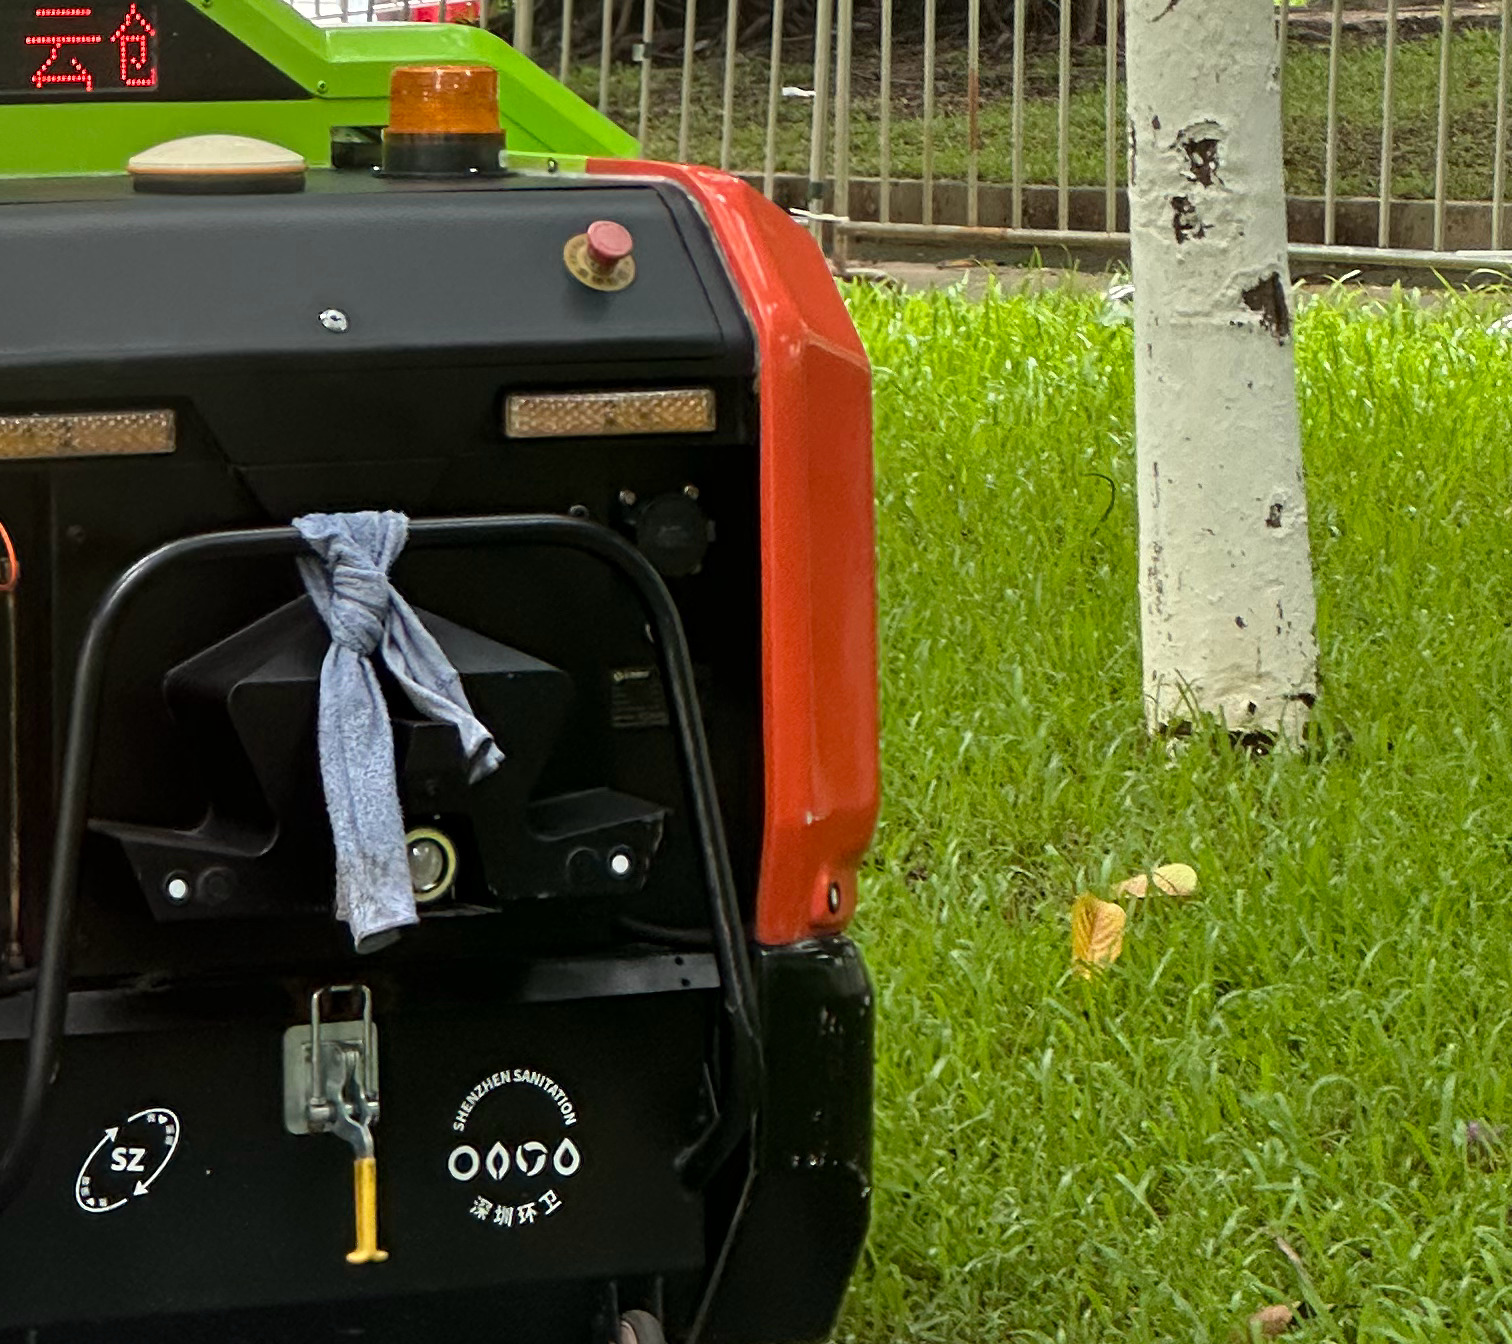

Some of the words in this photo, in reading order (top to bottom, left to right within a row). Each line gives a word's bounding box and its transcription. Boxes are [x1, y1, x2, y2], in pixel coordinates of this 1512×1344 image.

[452, 1069, 511, 1132] SHENZHEN
[512, 1068, 577, 1126] SANITATION
[110, 1146, 146, 1172] SZ
[469, 1189, 563, 1228] 深圳环卫
